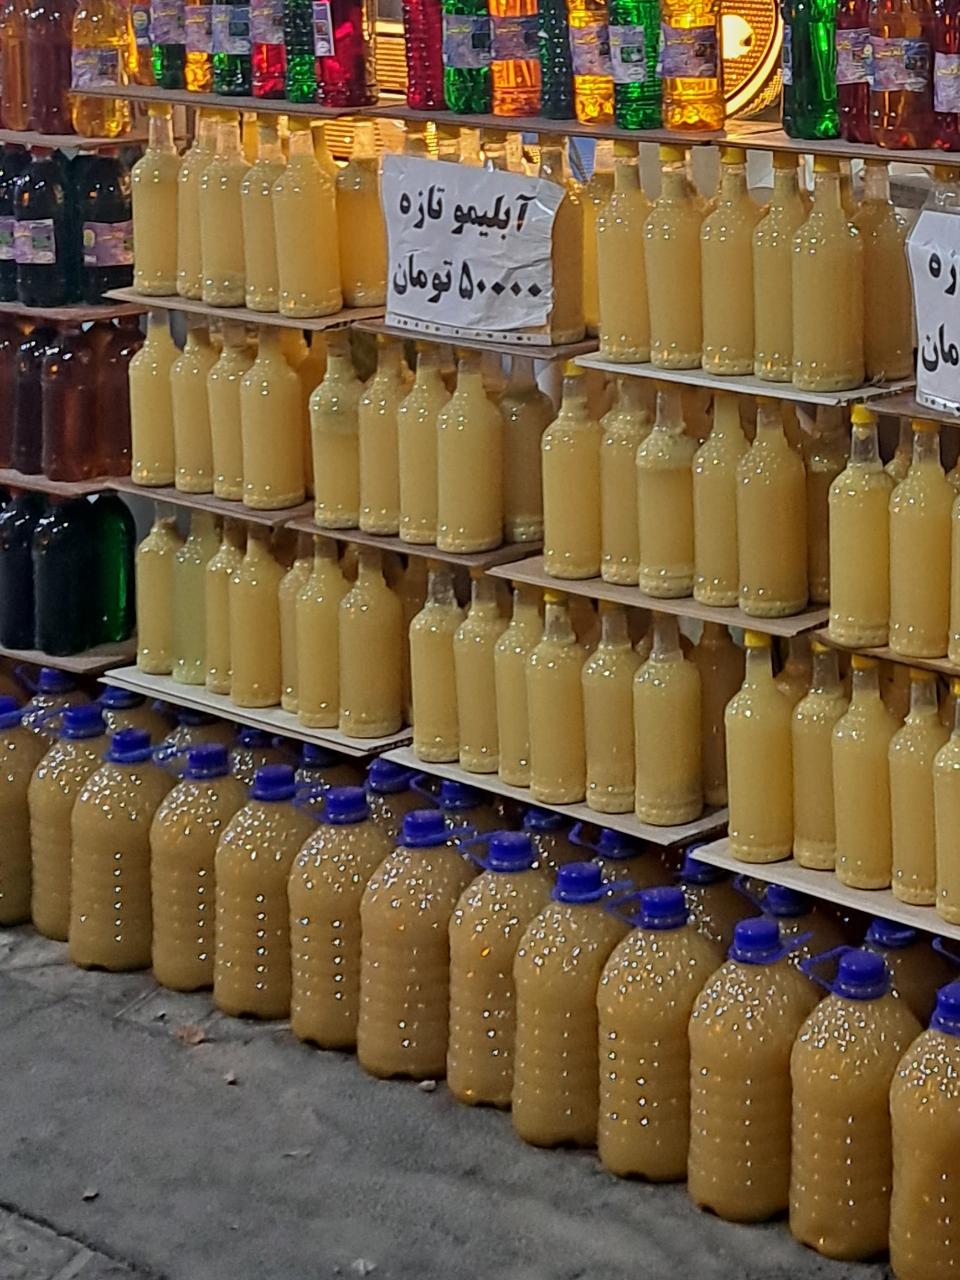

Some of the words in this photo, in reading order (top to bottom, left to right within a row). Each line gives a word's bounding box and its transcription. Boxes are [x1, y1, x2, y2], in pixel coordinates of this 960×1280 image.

[399, 184, 445, 229] تازه
[451, 193, 537, 240] آبلیمو
[393, 253, 453, 303] تومان
[458, 261, 542, 300] ۵۰۰۰۰
